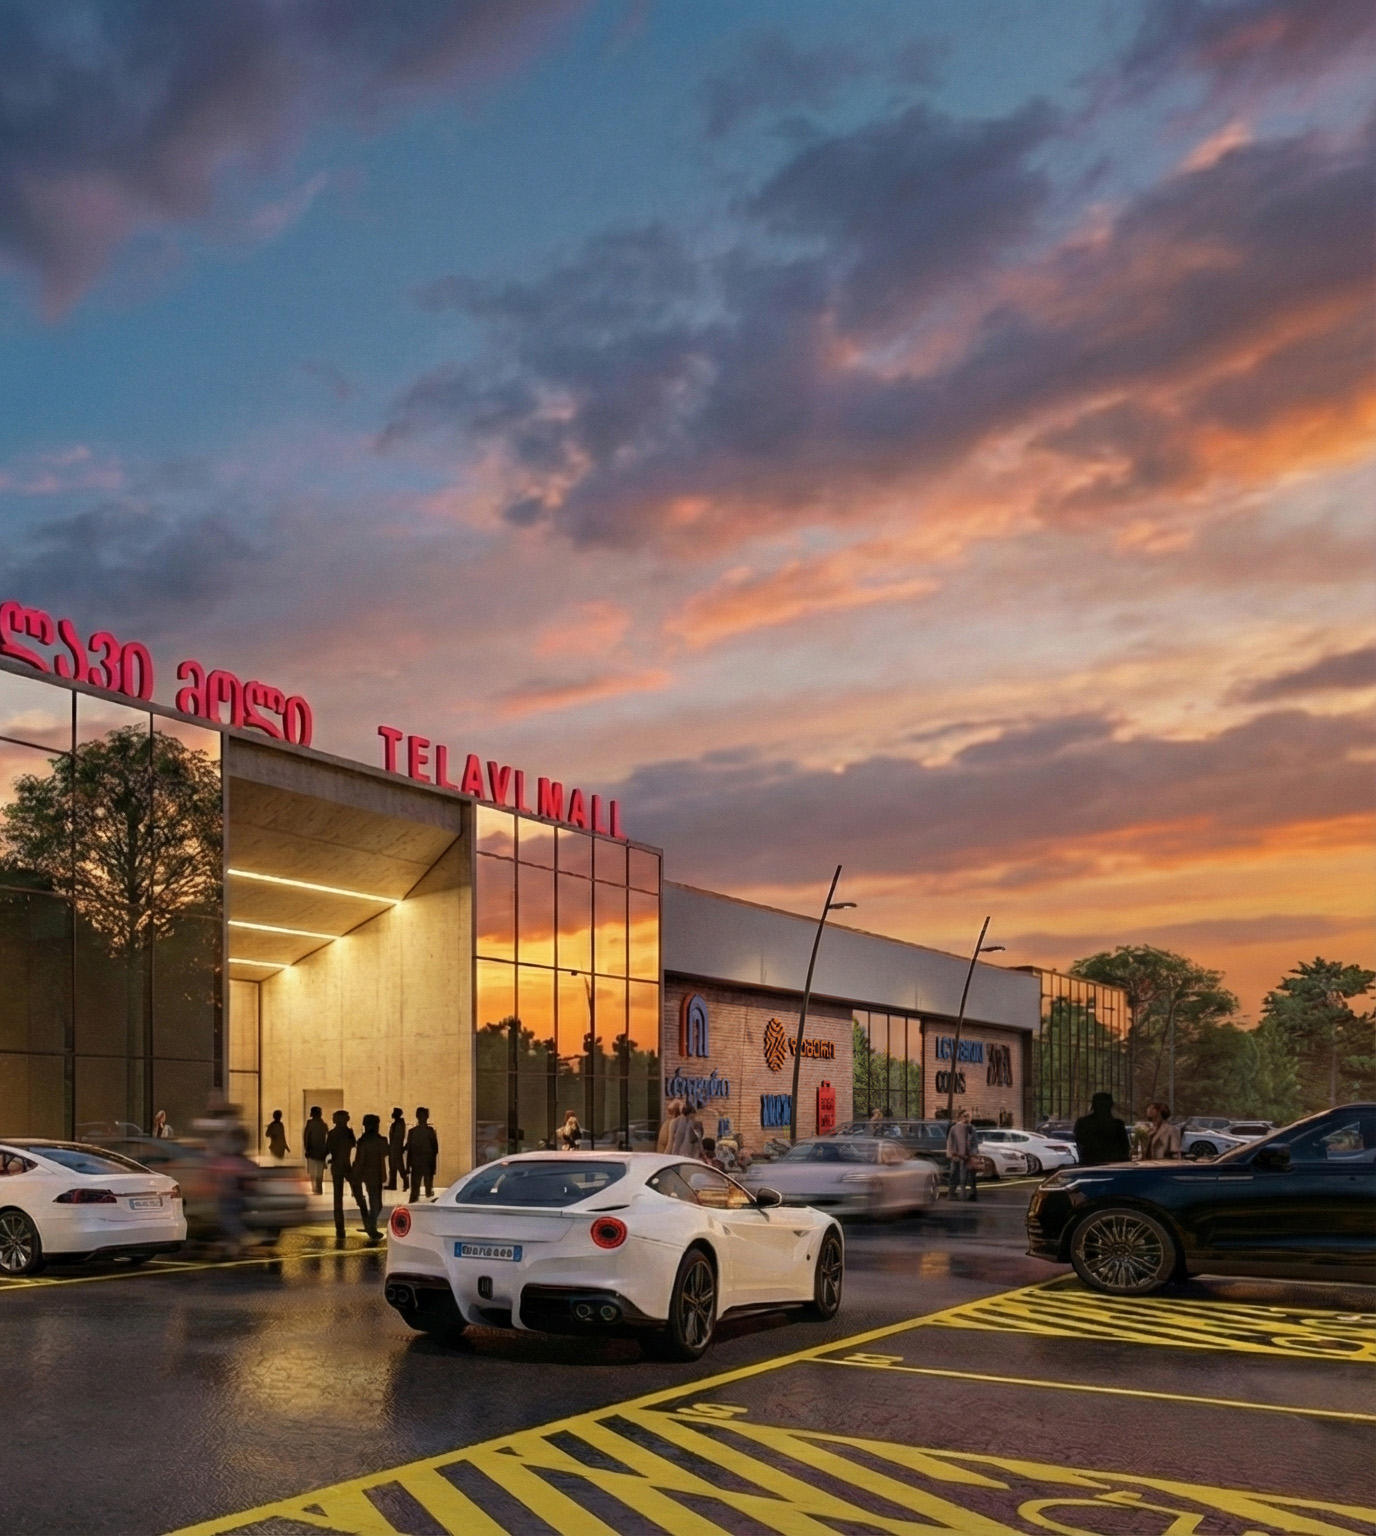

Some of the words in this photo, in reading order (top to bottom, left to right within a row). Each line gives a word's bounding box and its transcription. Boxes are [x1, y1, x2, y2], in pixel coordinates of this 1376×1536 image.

[176, 659, 313, 748] მოლი
[378, 725, 532, 813] TELAVI
[538, 777, 627, 840] MALL
